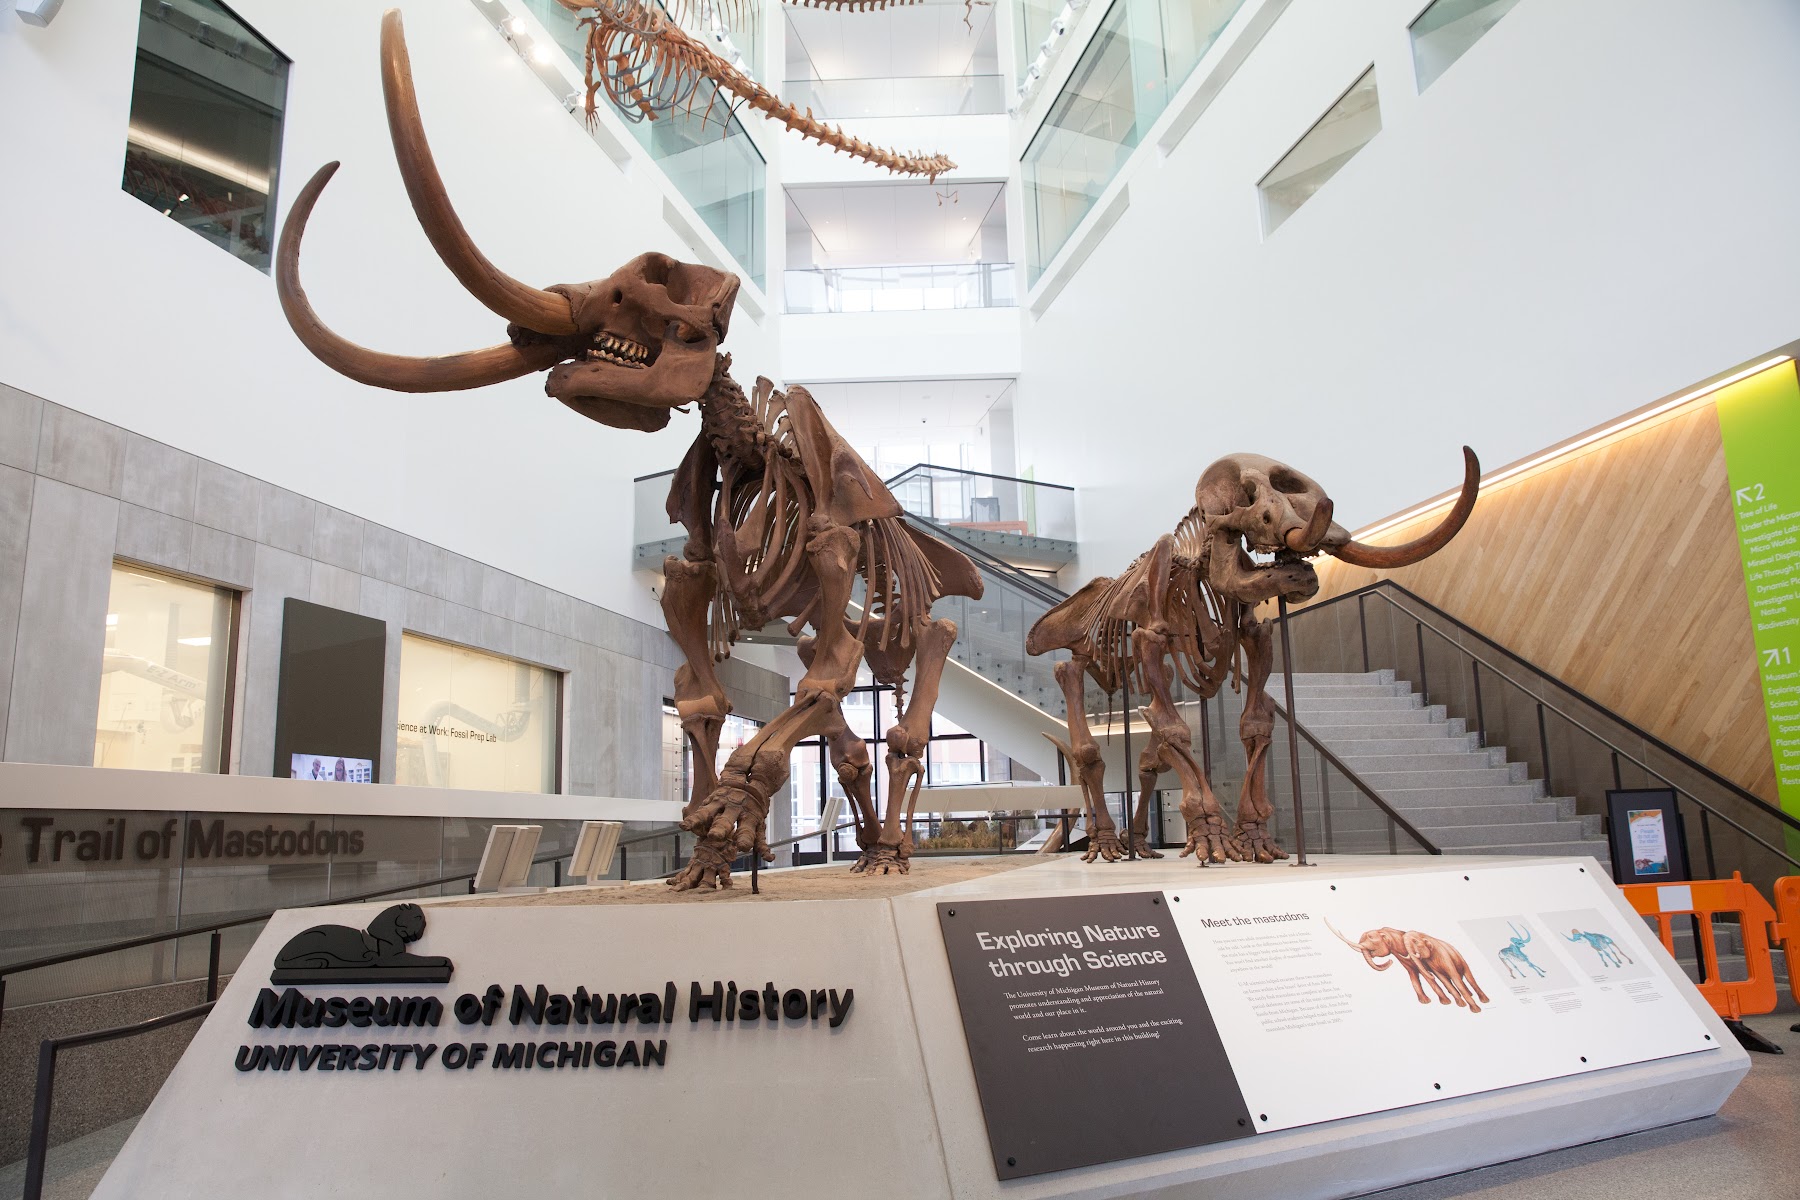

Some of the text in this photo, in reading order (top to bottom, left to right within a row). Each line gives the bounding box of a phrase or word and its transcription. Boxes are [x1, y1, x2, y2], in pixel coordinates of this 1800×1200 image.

[1753, 483, 1765, 501] 2
[1738, 503, 1777, 519] Tree of Life
[1741, 522, 1762, 532] Under
[1763, 518, 1775, 526] the
[1744, 530, 1782, 545] Investigate
[1750, 536, 1797, 553] Micro Worlds
[1747, 555, 1774, 568] Mineral
[1750, 572, 1763, 581] Life
[1763, 565, 1794, 578] Through
[1756, 580, 1789, 593] Dynamic
[1753, 594, 1794, 607] Investigate
[1760, 606, 1786, 616] Nature
[1757, 618, 1800, 631] Biodiversity
[1782, 646, 1790, 664] 1
[168, 674, 197, 689] Arm
[1765, 672, 1798, 681] Museum
[1768, 685, 1800, 696] Exploring
[1770, 700, 1798, 709] Science
[397, 720, 497, 743] ience at Work: Fossil Prep Lab
[21, 816, 126, 863] Trail
[136, 818, 178, 861] of
[187, 818, 365, 859] Mastodons
[1200, 912, 1310, 929] Meet the mastodons
[976, 924, 1160, 953] Exploring Nature
[989, 950, 1167, 978] through Science
[1055, 986, 1083, 994] Michigan
[248, 980, 854, 1028] Museum of Natural History
[1009, 1002, 1037, 1011] promotes
[1038, 997, 1081, 1007] understanding
[1093, 993, 1127, 1002] appreciation
[1144, 988, 1164, 996] natural
[1013, 1012, 1031, 1020] world
[1056, 1009, 1072, 1017] place
[1077, 1028, 1087, 1036] the
[1088, 1026, 1106, 1034] world
[1106, 1024, 1126, 1032] around
[1028, 1043, 1053, 1053] research
[1053, 1041, 1086, 1050] happening
[1086, 1038, 1101, 1047] right
[234, 1039, 668, 1071] UNIVERSITY OF MICHIGAN
